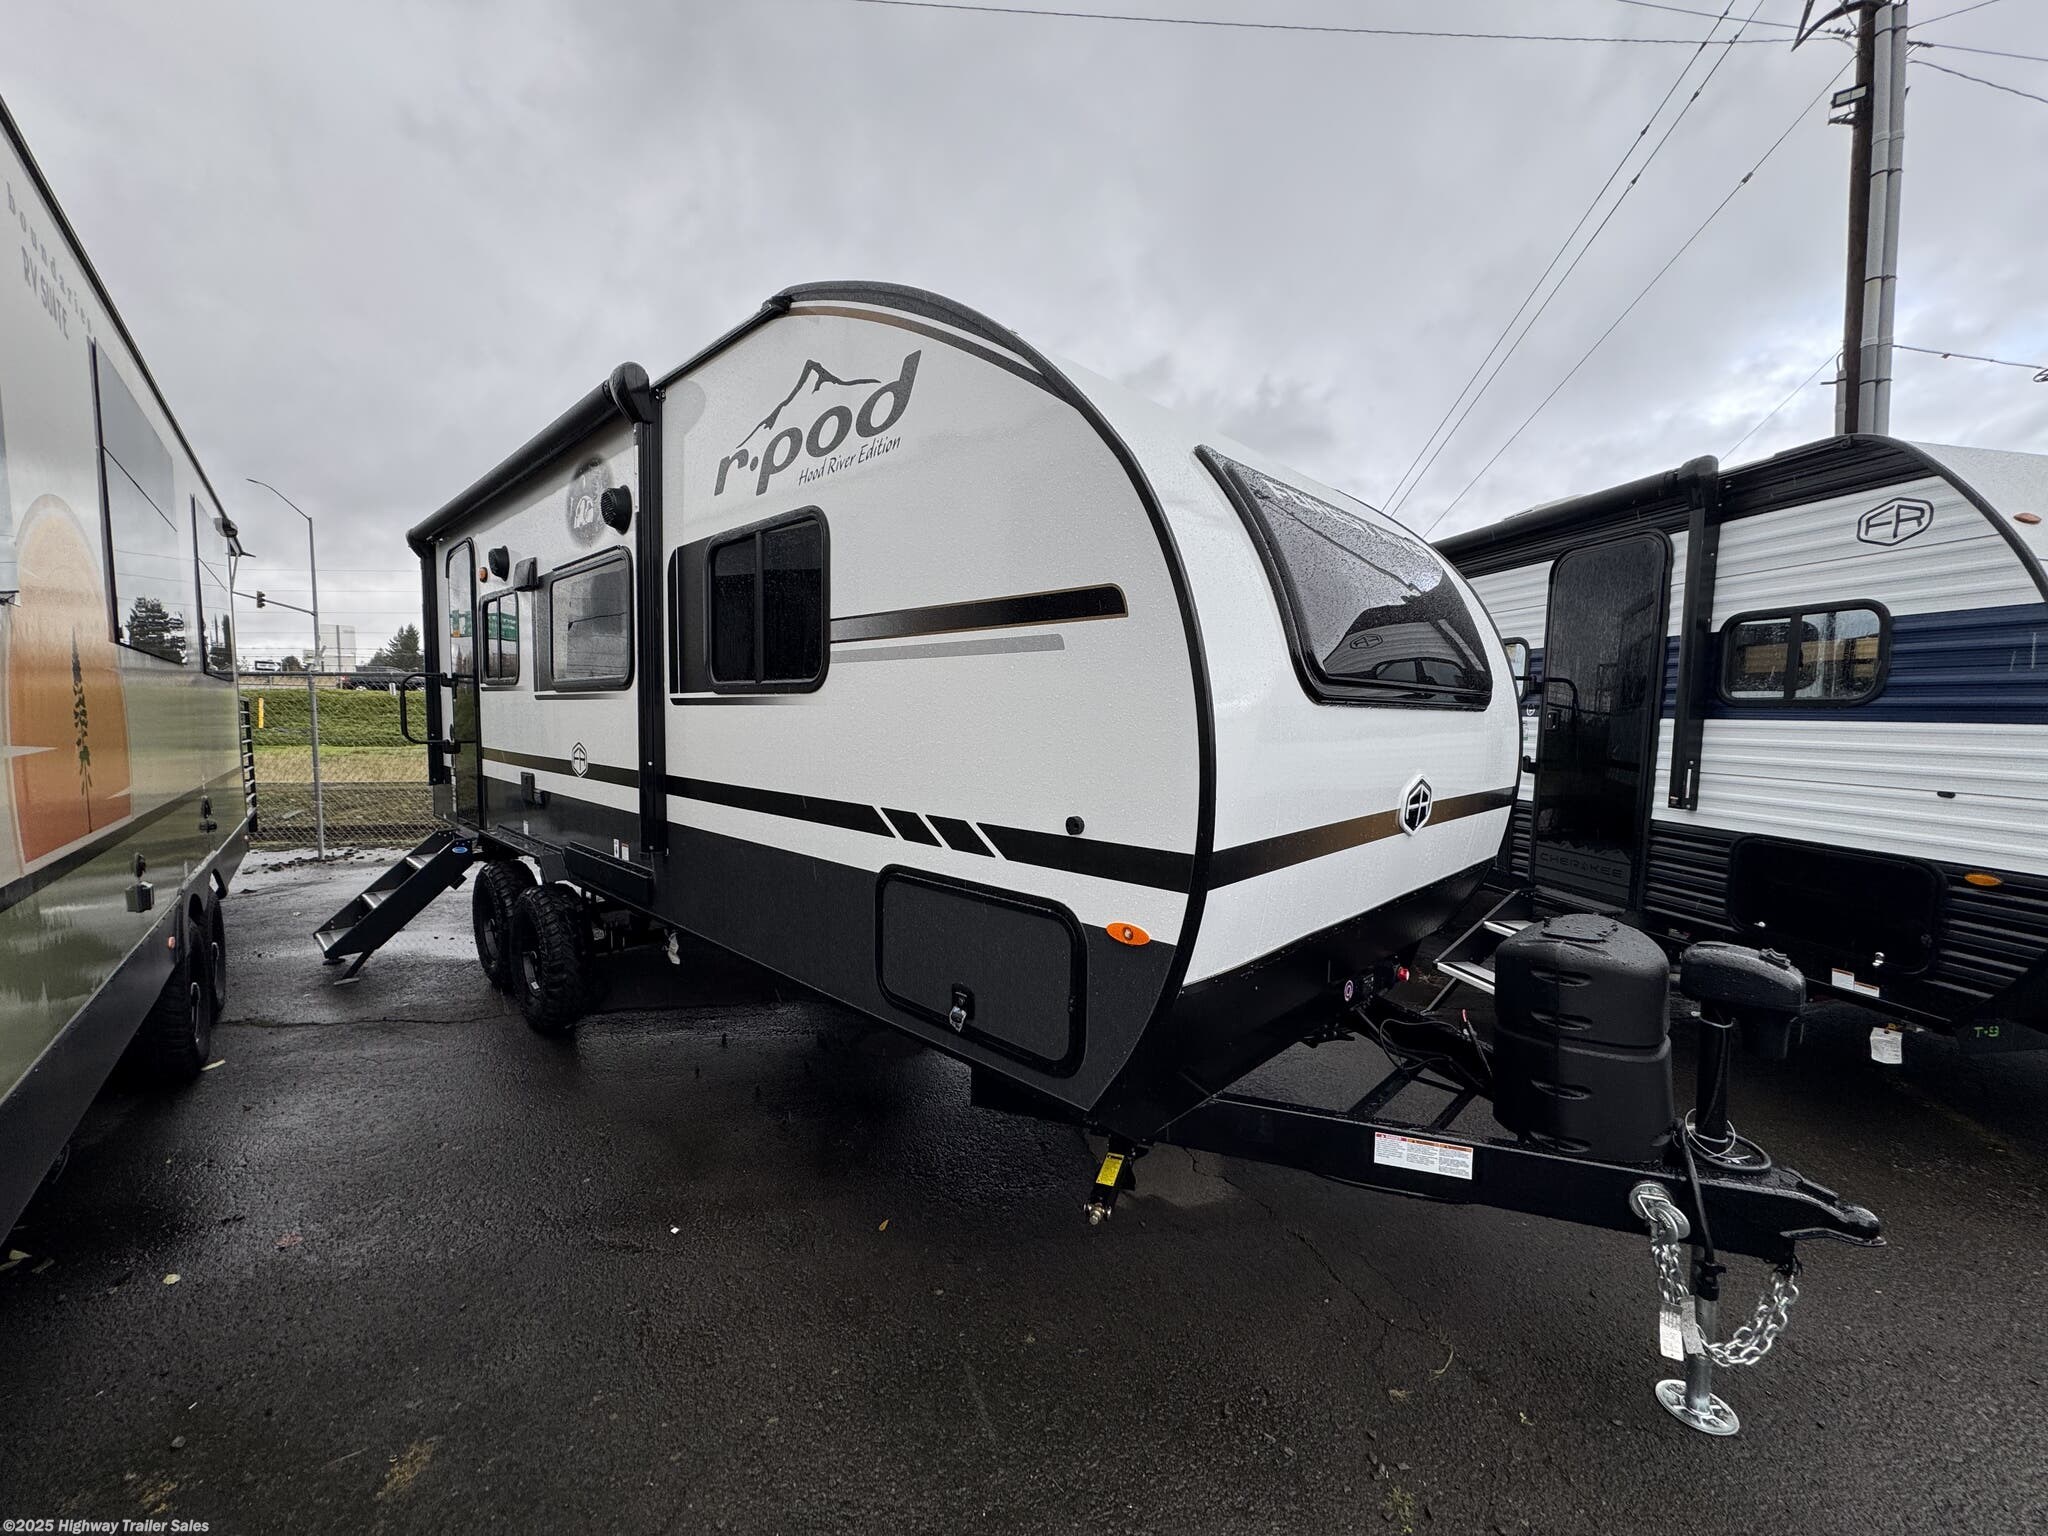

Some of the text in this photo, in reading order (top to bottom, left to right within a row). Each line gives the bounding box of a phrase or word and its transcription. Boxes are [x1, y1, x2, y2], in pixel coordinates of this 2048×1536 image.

[21, 245, 69, 341] RV SUITE
[798, 436, 902, 486] Hood River Edition
